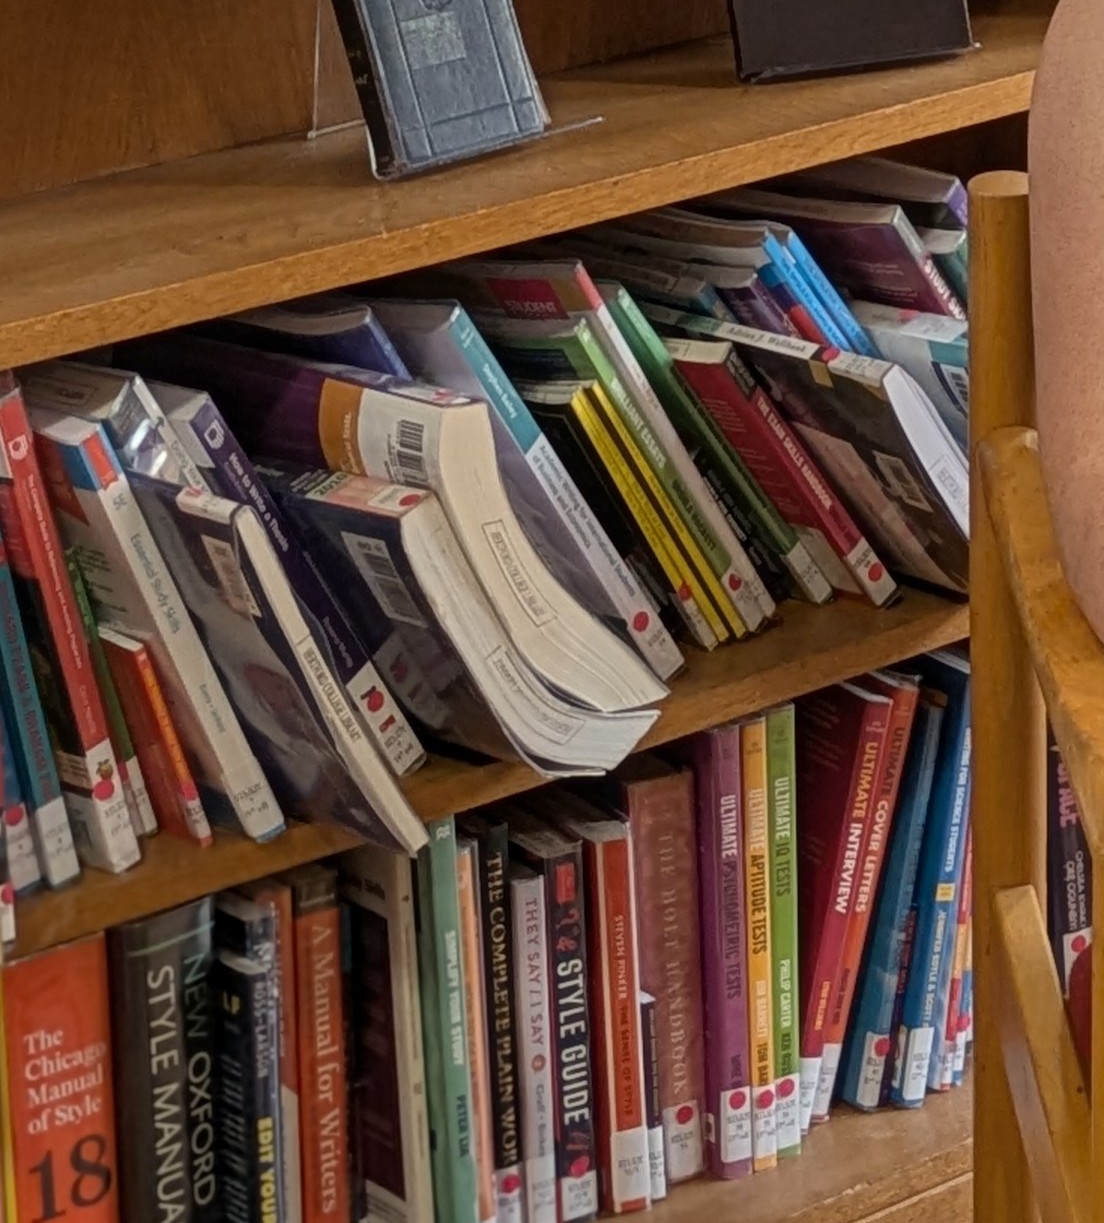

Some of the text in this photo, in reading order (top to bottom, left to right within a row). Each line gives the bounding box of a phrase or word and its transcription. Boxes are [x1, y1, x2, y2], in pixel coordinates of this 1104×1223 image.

[754, 396, 772, 417] THE
[765, 412, 787, 439] EXAM
[781, 436, 806, 467] SKILLS
[227, 451, 246, 476] How
[240, 473, 253, 488] to
[246, 483, 269, 513] Write
[262, 511, 273, 521] a
[266, 517, 292, 552] Thesis
[127, 532, 160, 579] Essential
[148, 577, 172, 608] Study
[162, 605, 184, 634] Skills
[957, 766, 968, 785] FOR
[834, 740, 877, 914] ULTIMATE INTERVIEW
[853, 725, 907, 914] ULTIMATE COVER LETTERS
[950, 785, 965, 824] SCIENCE
[771, 776, 791, 896] ULTIMATE IQ TESTS
[944, 825, 959, 872] STUDENTS
[484, 852, 504, 903] THE
[747, 788, 768, 954] ULTIMATE APTITUDE TESTS
[719, 793, 742, 998] ULTIMATE PSYCHOMETRIC TESTS
[525, 898, 539, 944] THEY
[612, 914, 626, 956] STEVEN
[488, 907, 513, 1031] COMPLETE
[527, 953, 541, 983] SAY
[614, 959, 628, 999] PINKER
[657, 833, 690, 1095] THE HOLT HANDBOOK
[778, 958, 791, 991] PHILIP
[145, 965, 179, 1075] STYLE
[530, 1014, 543, 1045] SAY
[779, 992, 793, 1028] CARTER
[23, 1030, 64, 1055] The
[24, 1041, 107, 1082] Chicago
[450, 1026, 464, 1064] STUDY
[556, 957, 590, 1125] STYLE GUIDE
[28, 1062, 104, 1108] Manual
[181, 952, 219, 1205] NEW OXFORD
[311, 925, 343, 1214] A Manual for Writers
[496, 1035, 517, 1102] PLAIN
[28, 1094, 102, 1135] of Style
[622, 1084, 636, 1116] STYLE
[256, 1116, 273, 1162] EDIT
[28, 1134, 112, 1223] 18
